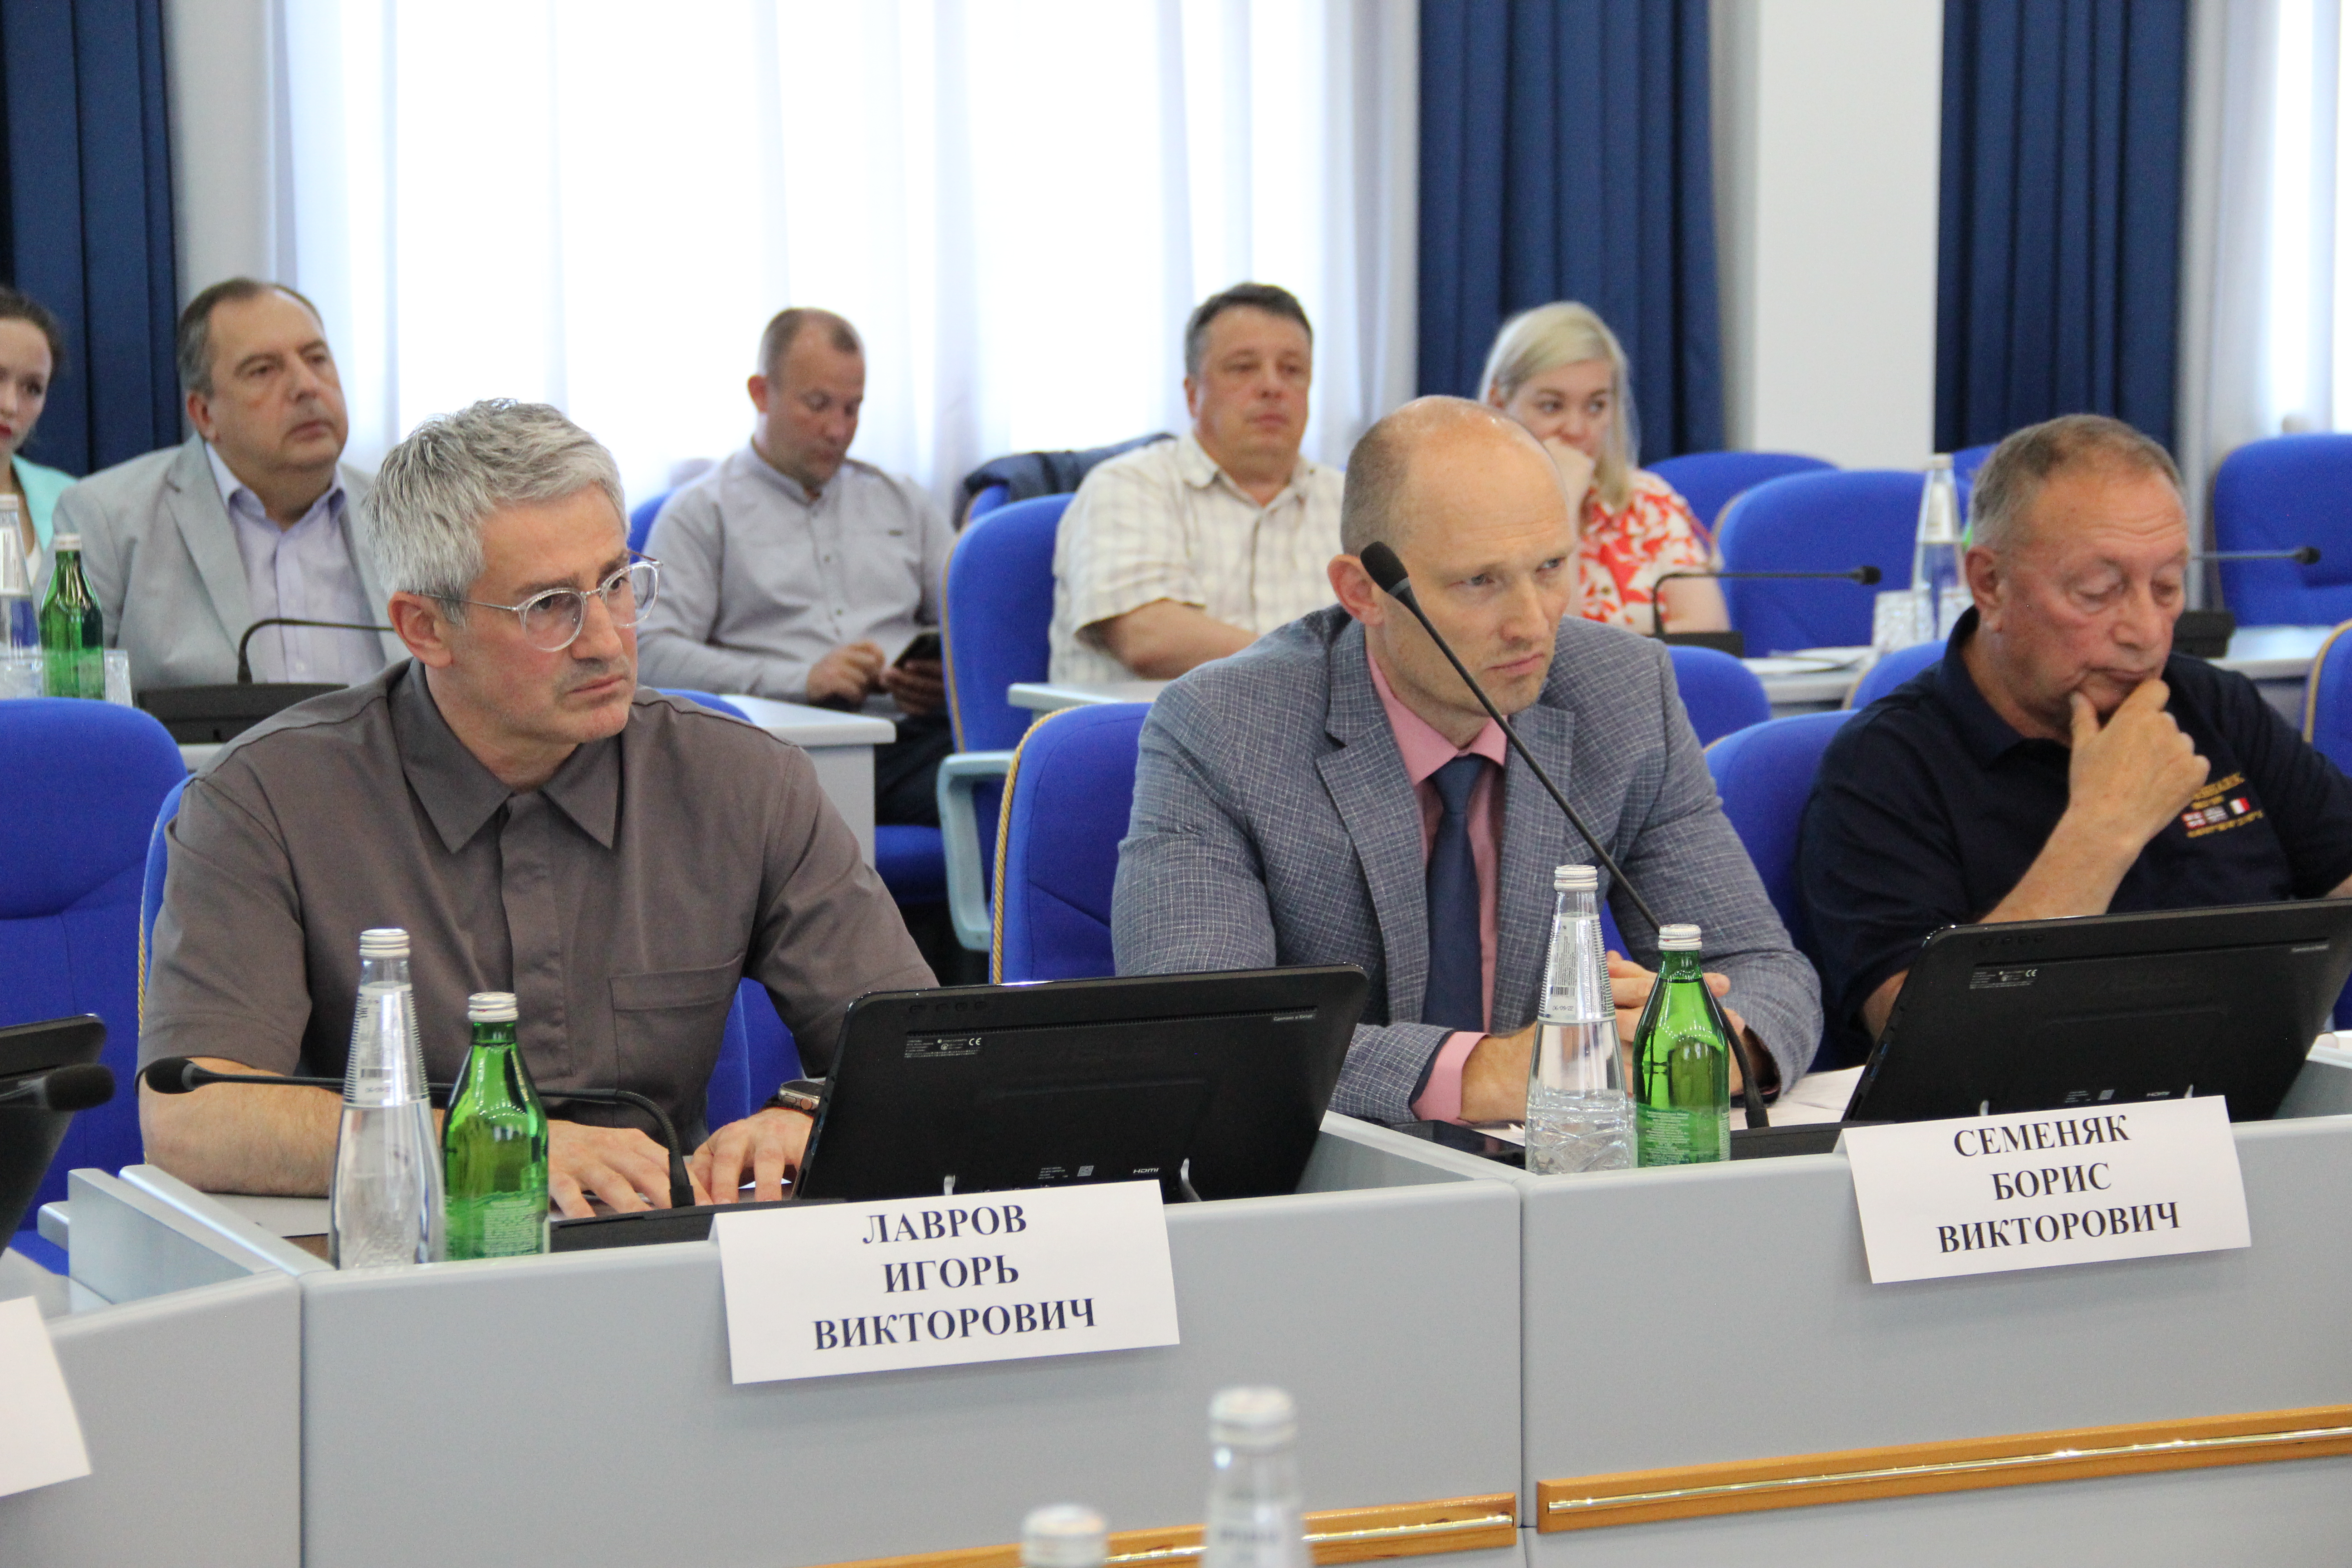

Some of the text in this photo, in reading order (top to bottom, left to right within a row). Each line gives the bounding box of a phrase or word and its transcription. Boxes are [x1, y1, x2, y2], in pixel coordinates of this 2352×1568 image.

[1954, 1114, 2132, 1156] СЕМЕНЯК
[1990, 1162, 2111, 1200] БОРИС
[862, 1205, 1027, 1245] ЛАВРОВ
[1936, 1202, 2181, 1253] ВИКТОРОВИЧ
[882, 1255, 1019, 1293] ИГОРЬ
[813, 1298, 1096, 1350] ВИКТОРОВИЧ
